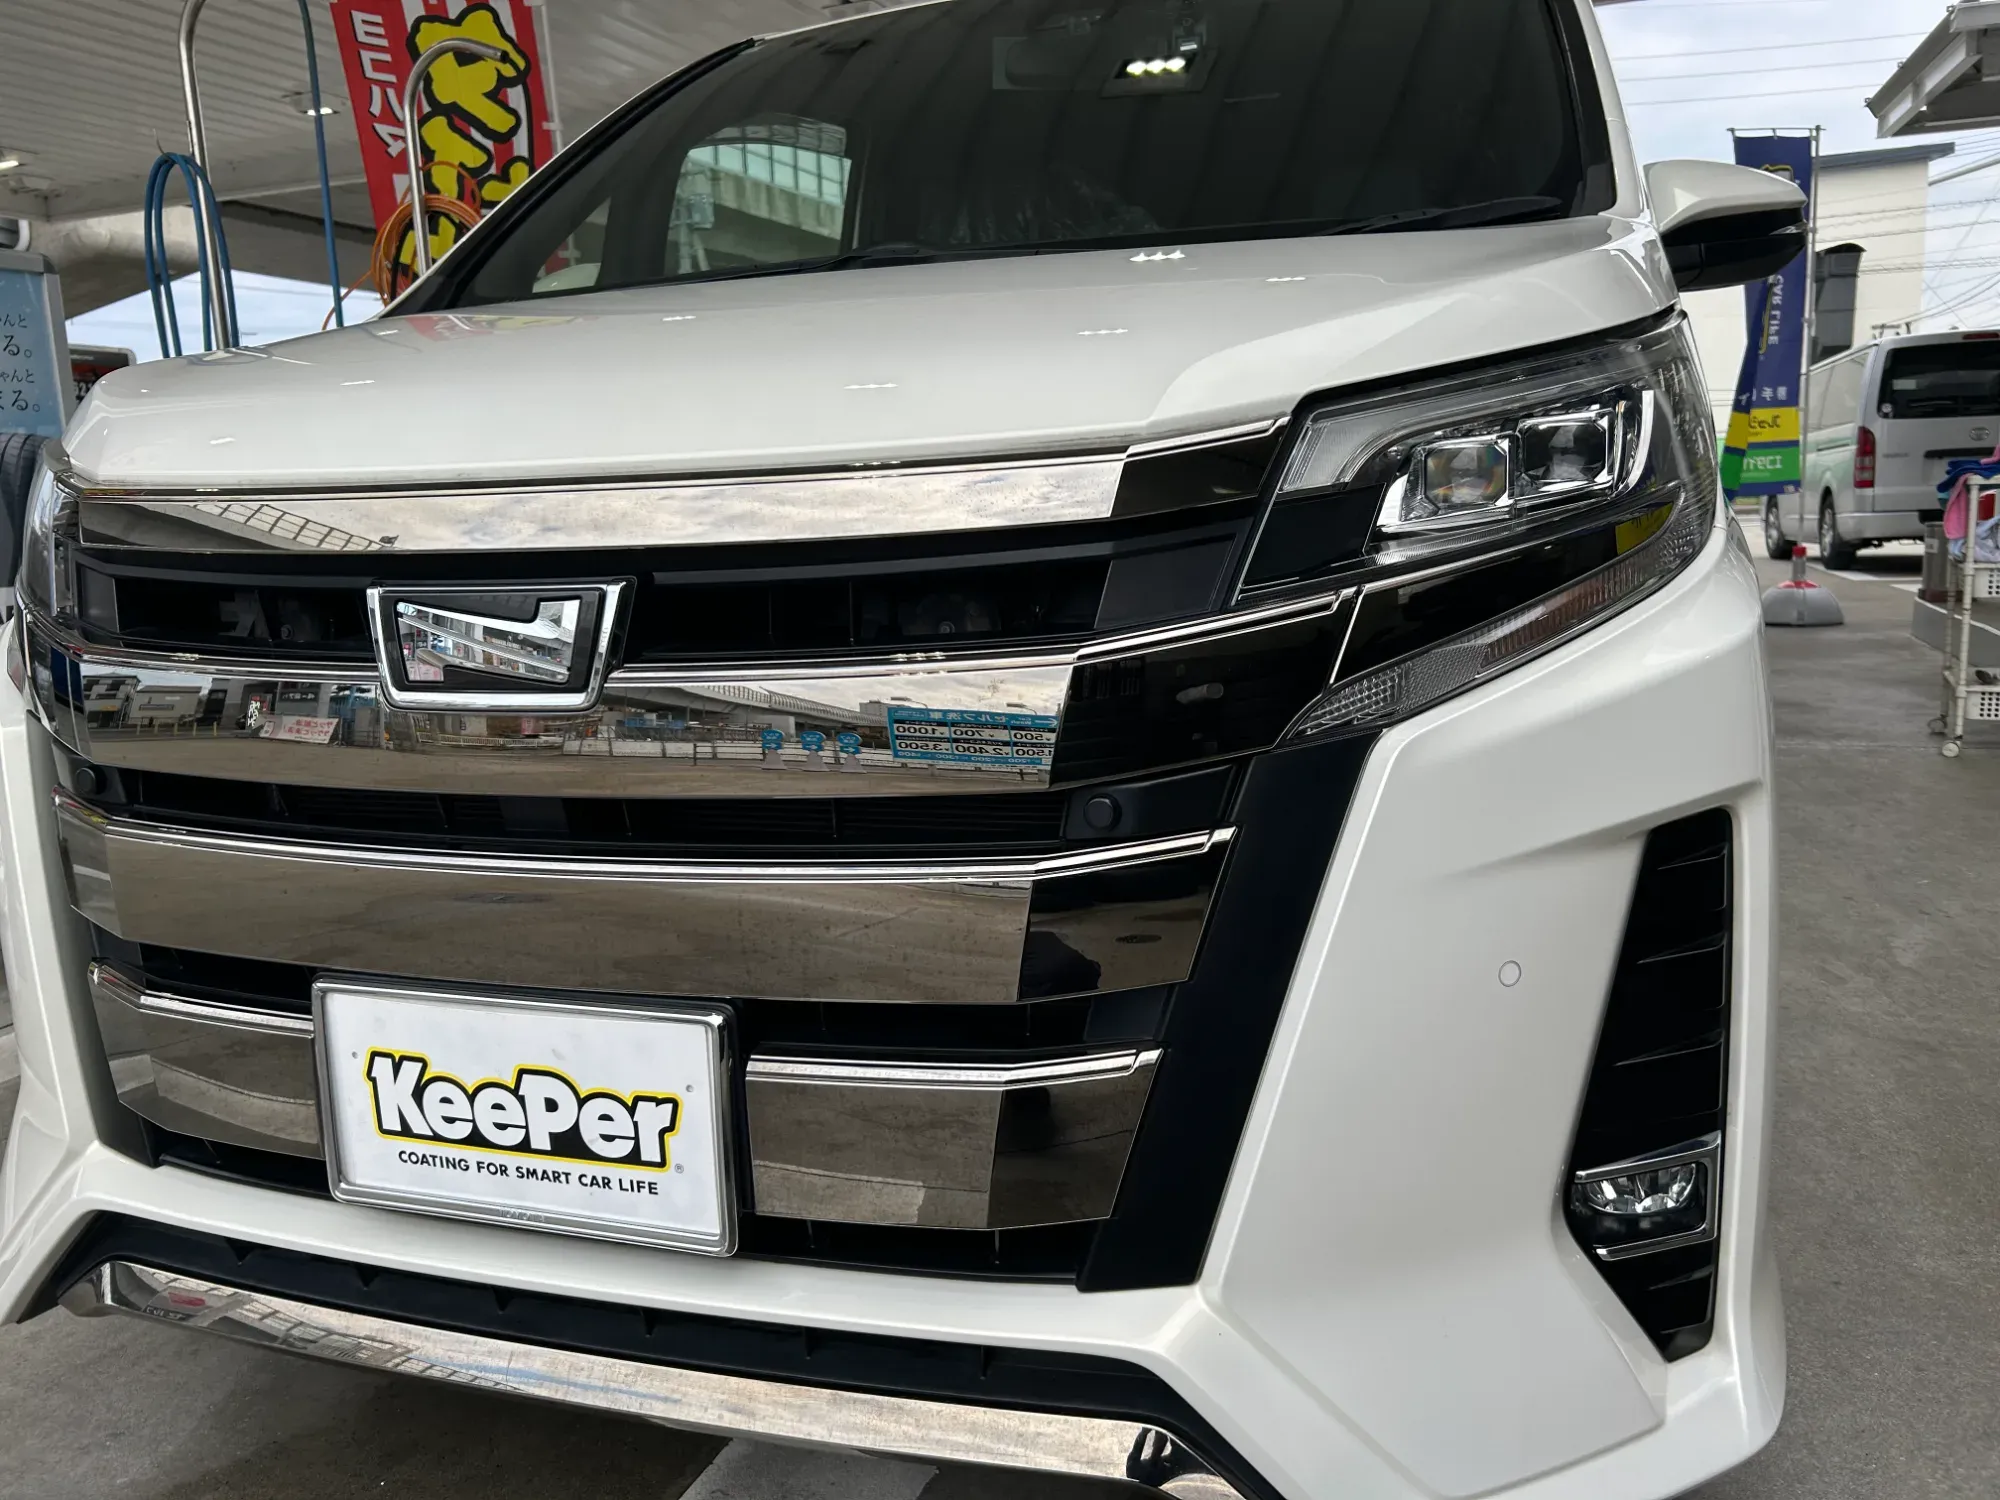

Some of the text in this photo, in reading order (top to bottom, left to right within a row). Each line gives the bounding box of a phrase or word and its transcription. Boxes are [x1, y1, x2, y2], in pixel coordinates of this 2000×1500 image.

[0, 313, 28, 329] んと
[366, 1050, 680, 1168] KeePer
[398, 1150, 659, 1196] COATING FOR SMART CAR LIFE
